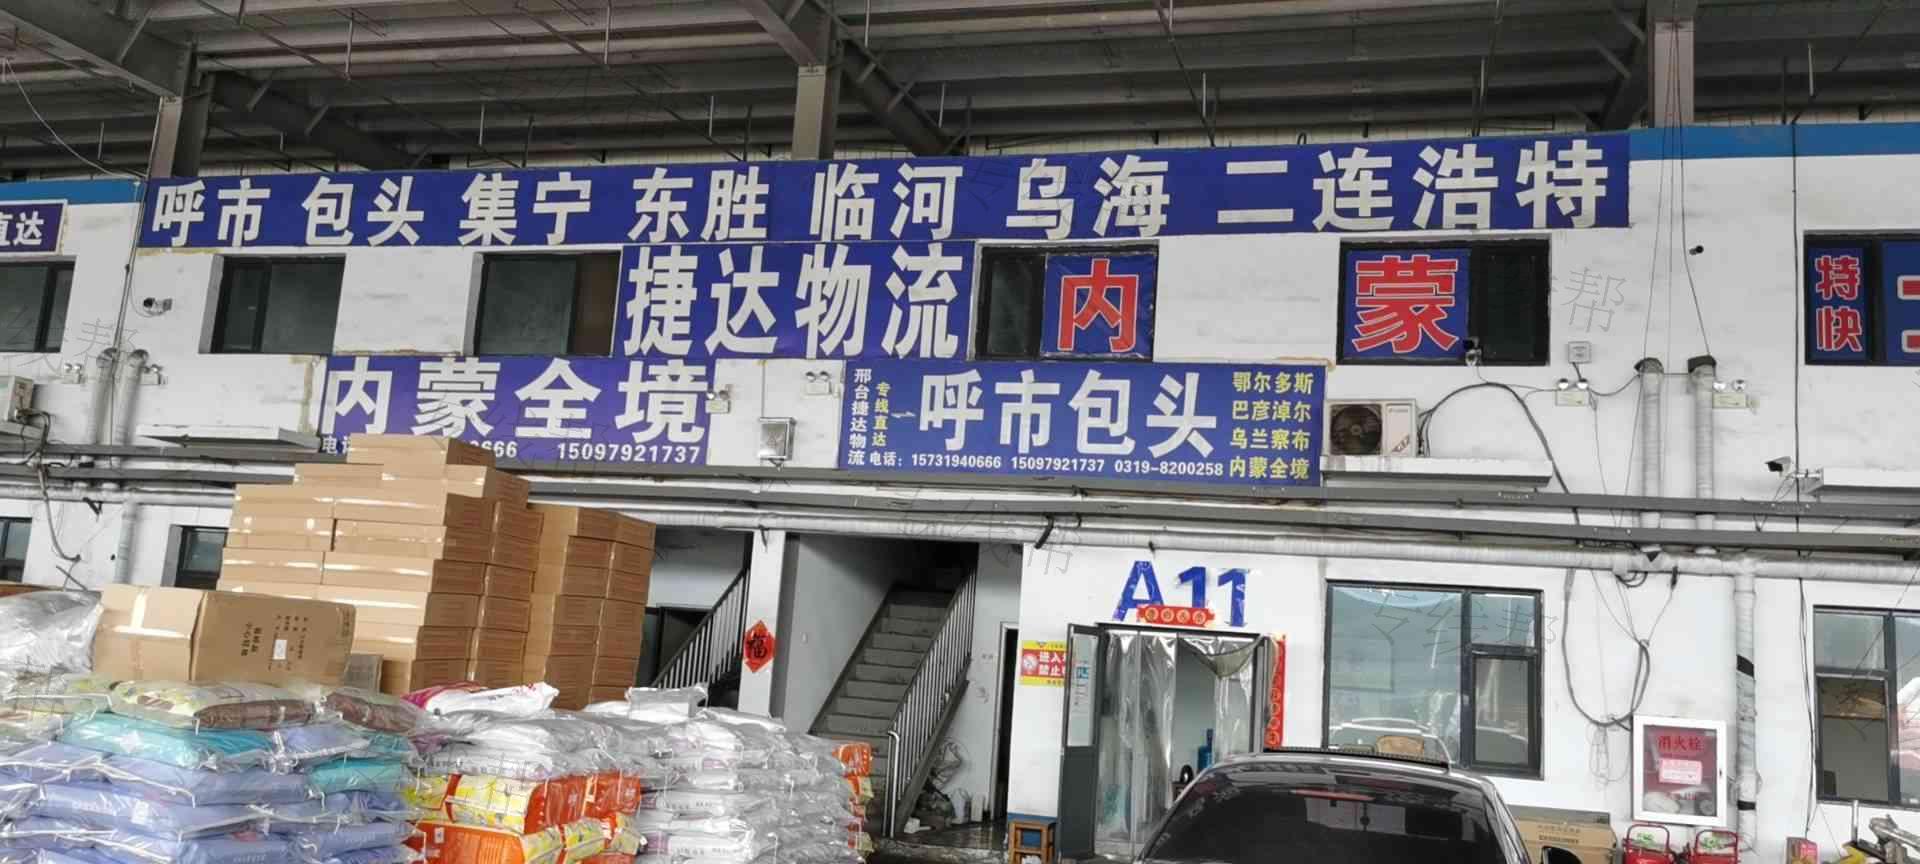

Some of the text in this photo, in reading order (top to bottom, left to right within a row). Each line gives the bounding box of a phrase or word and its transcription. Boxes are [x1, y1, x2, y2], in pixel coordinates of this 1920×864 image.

[153, 136, 1608, 247] 呼市 包头 集宁 东胜 临河 乌海 二连浩特
[624, 243, 964, 358] 捷达物流
[1056, 259, 1139, 352] 内
[1352, 255, 1459, 354] 蒙
[1815, 253, 1863, 352] 特快
[322, 356, 708, 444] 内蒙全境
[847, 368, 873, 466] 邢台捷达物流
[871, 380, 892, 447] 专线直达
[918, 370, 1217, 459] 呼市包头
[1231, 371, 1314, 395] 鄂尔多斯
[1231, 400, 1312, 424] 巴彦淖尔
[557, 440, 701, 464] 15097921737
[911, 453, 1002, 470] 15731940666
[1011, 456, 1105, 473] 15097921737
[1114, 459, 1224, 478] 0319-8200258
[1229, 426, 1311, 452] 乌兰察布
[1229, 455, 1311, 481] 内蒙全境
[1112, 560, 1248, 627] A11
